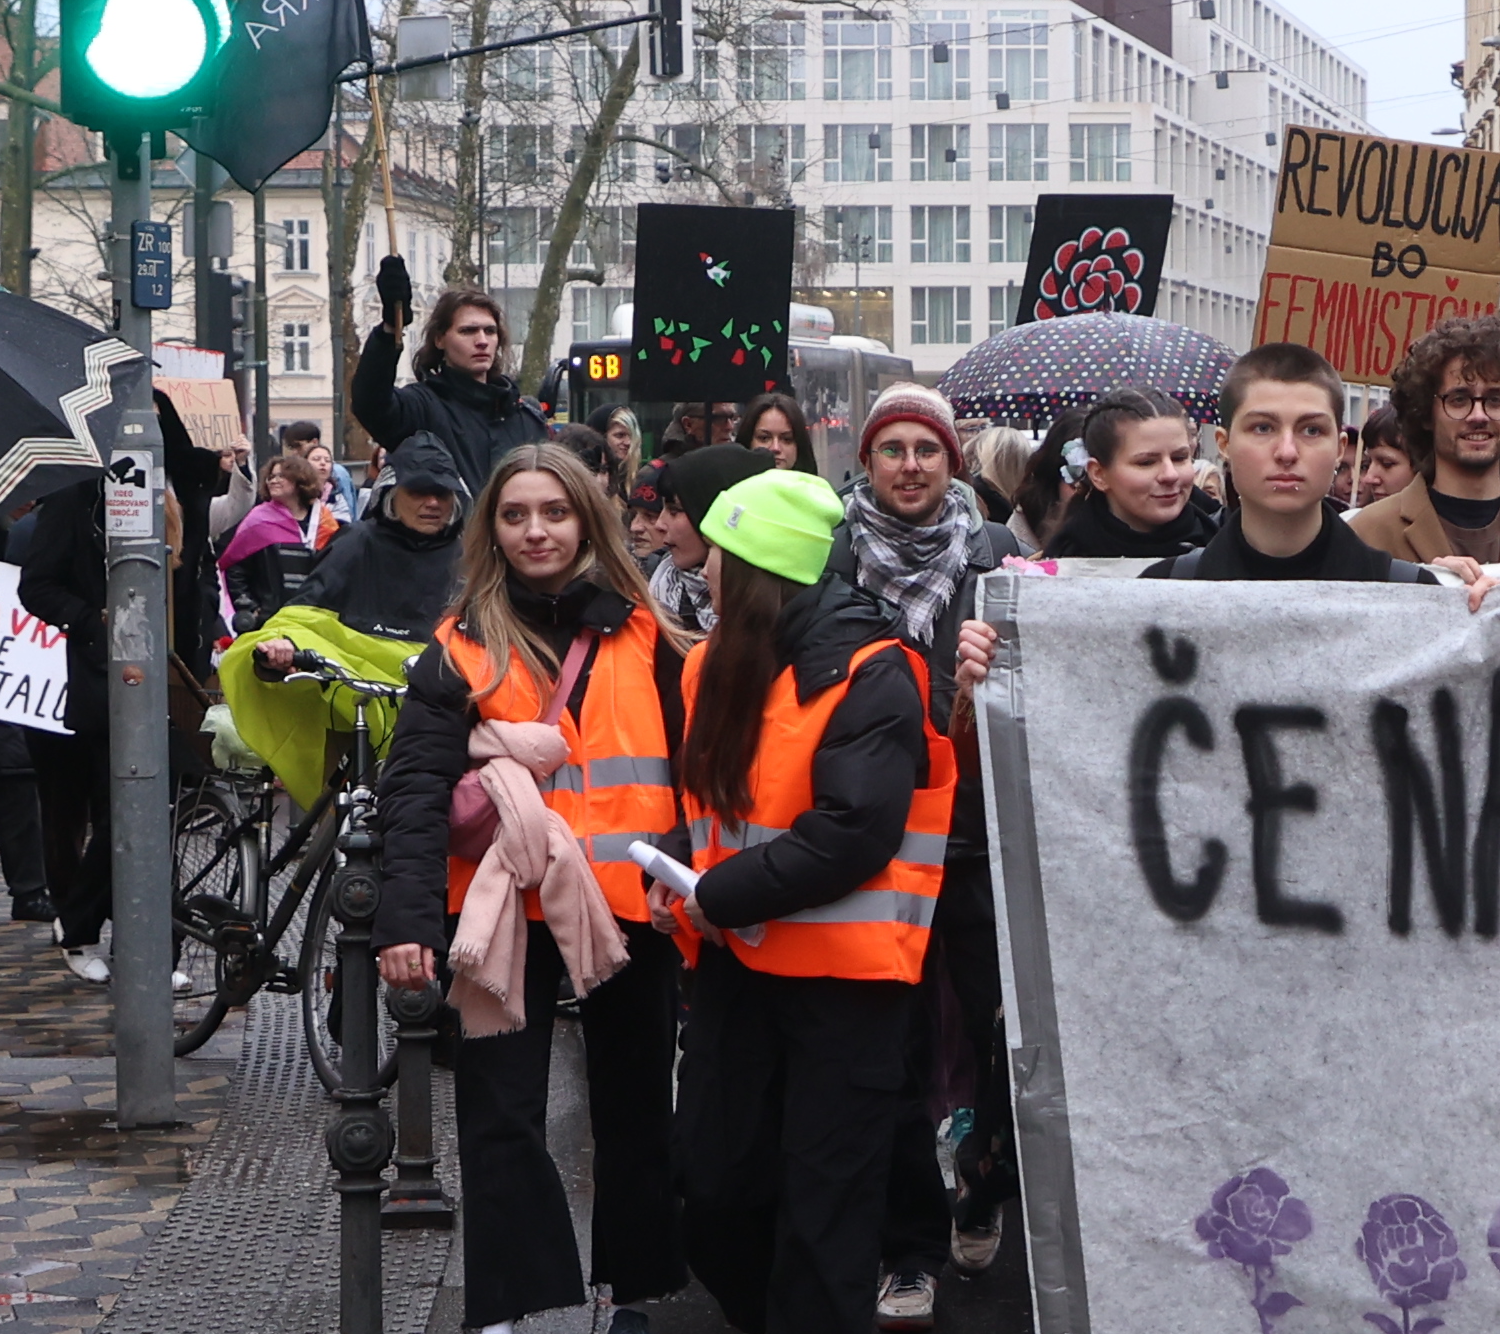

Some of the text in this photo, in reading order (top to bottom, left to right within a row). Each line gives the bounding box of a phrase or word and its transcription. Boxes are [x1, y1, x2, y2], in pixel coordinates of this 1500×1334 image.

[137, 232, 155, 252] ZR
[1371, 242, 1427, 279] BO
[1259, 272, 1496, 376] FEMINIST
[589, 354, 621, 380] 6B
[1128, 624, 1345, 935] ČE
